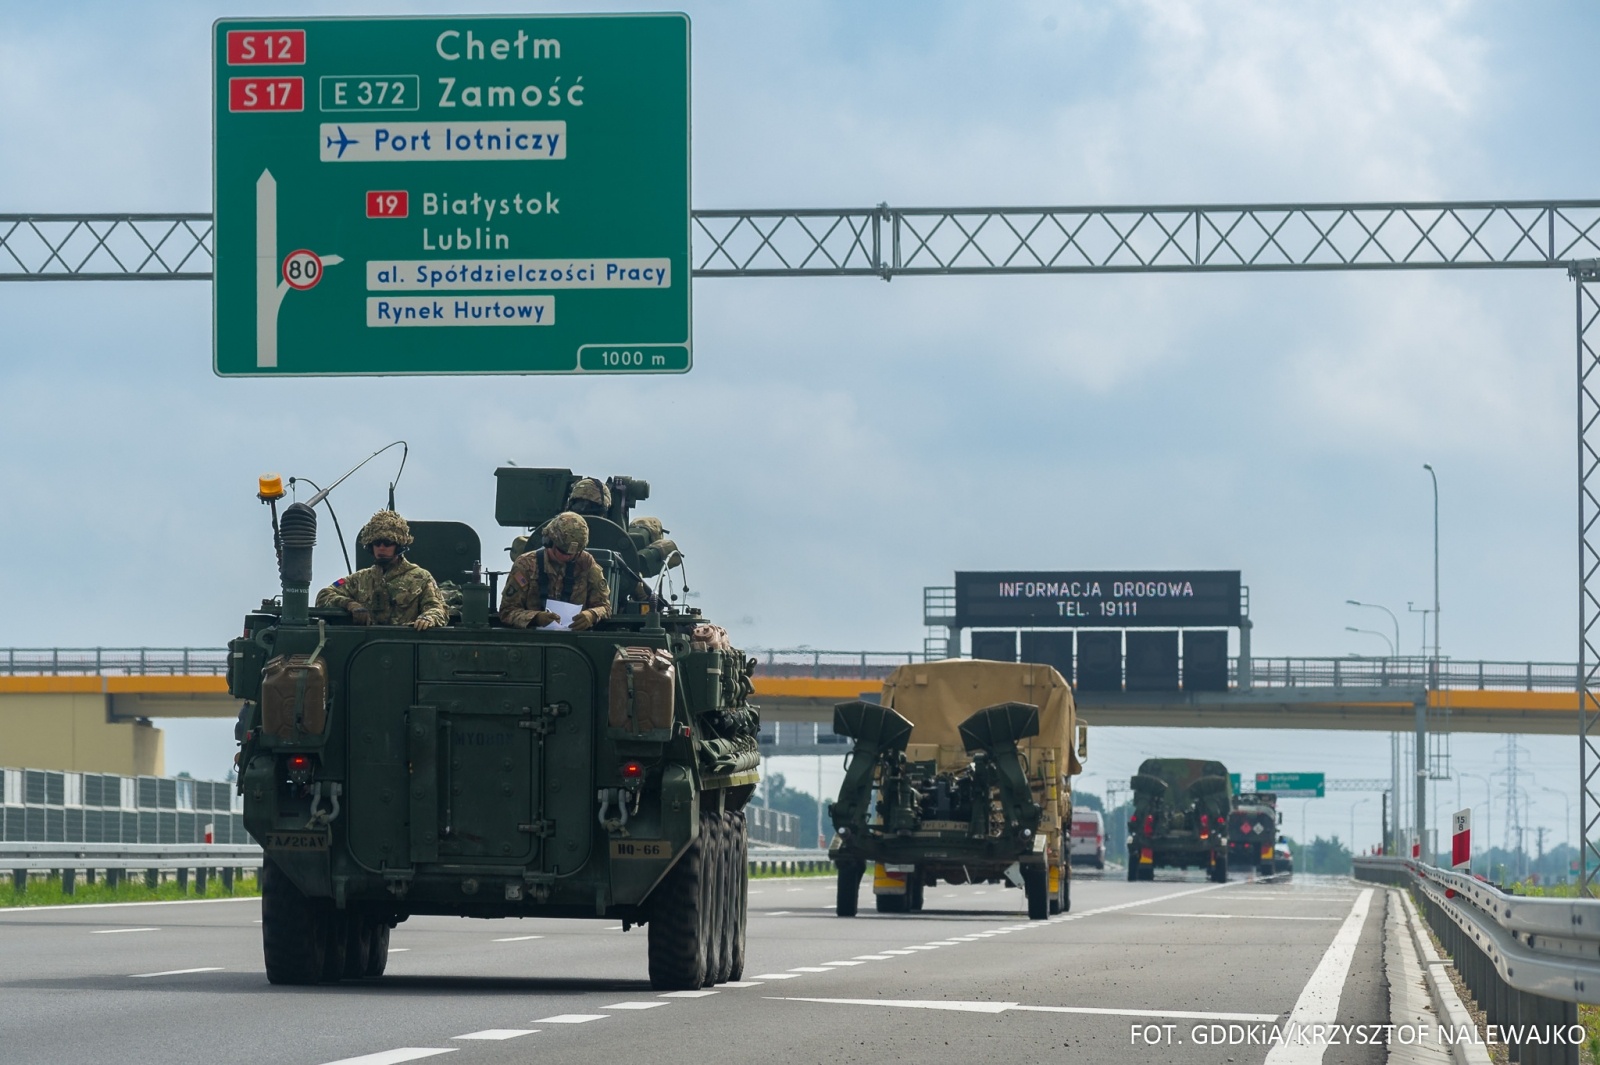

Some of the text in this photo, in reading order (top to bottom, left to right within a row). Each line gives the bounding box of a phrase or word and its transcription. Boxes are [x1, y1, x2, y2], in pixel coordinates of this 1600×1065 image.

[241, 35, 292, 60] S 12
[435, 29, 561, 61] Chełm
[243, 82, 292, 107] S 17
[334, 82, 405, 105] E 372
[438, 76, 584, 108] Zamość
[375, 127, 560, 157] Port lotniczy
[376, 195, 399, 214] 19
[423, 191, 560, 222] Białystok
[423, 227, 509, 251] Lublin
[289, 260, 317, 279] 80
[377, 263, 666, 288] al. Spółdzielczości Pracy
[377, 301, 545, 324] Rynek Hurtowy
[602, 351, 665, 366] 1000 m
[999, 582, 1194, 598] INFORMACJA DROGOWA
[1056, 601, 1138, 617] TEL. 19111
[617, 843, 661, 855] HQ-66
